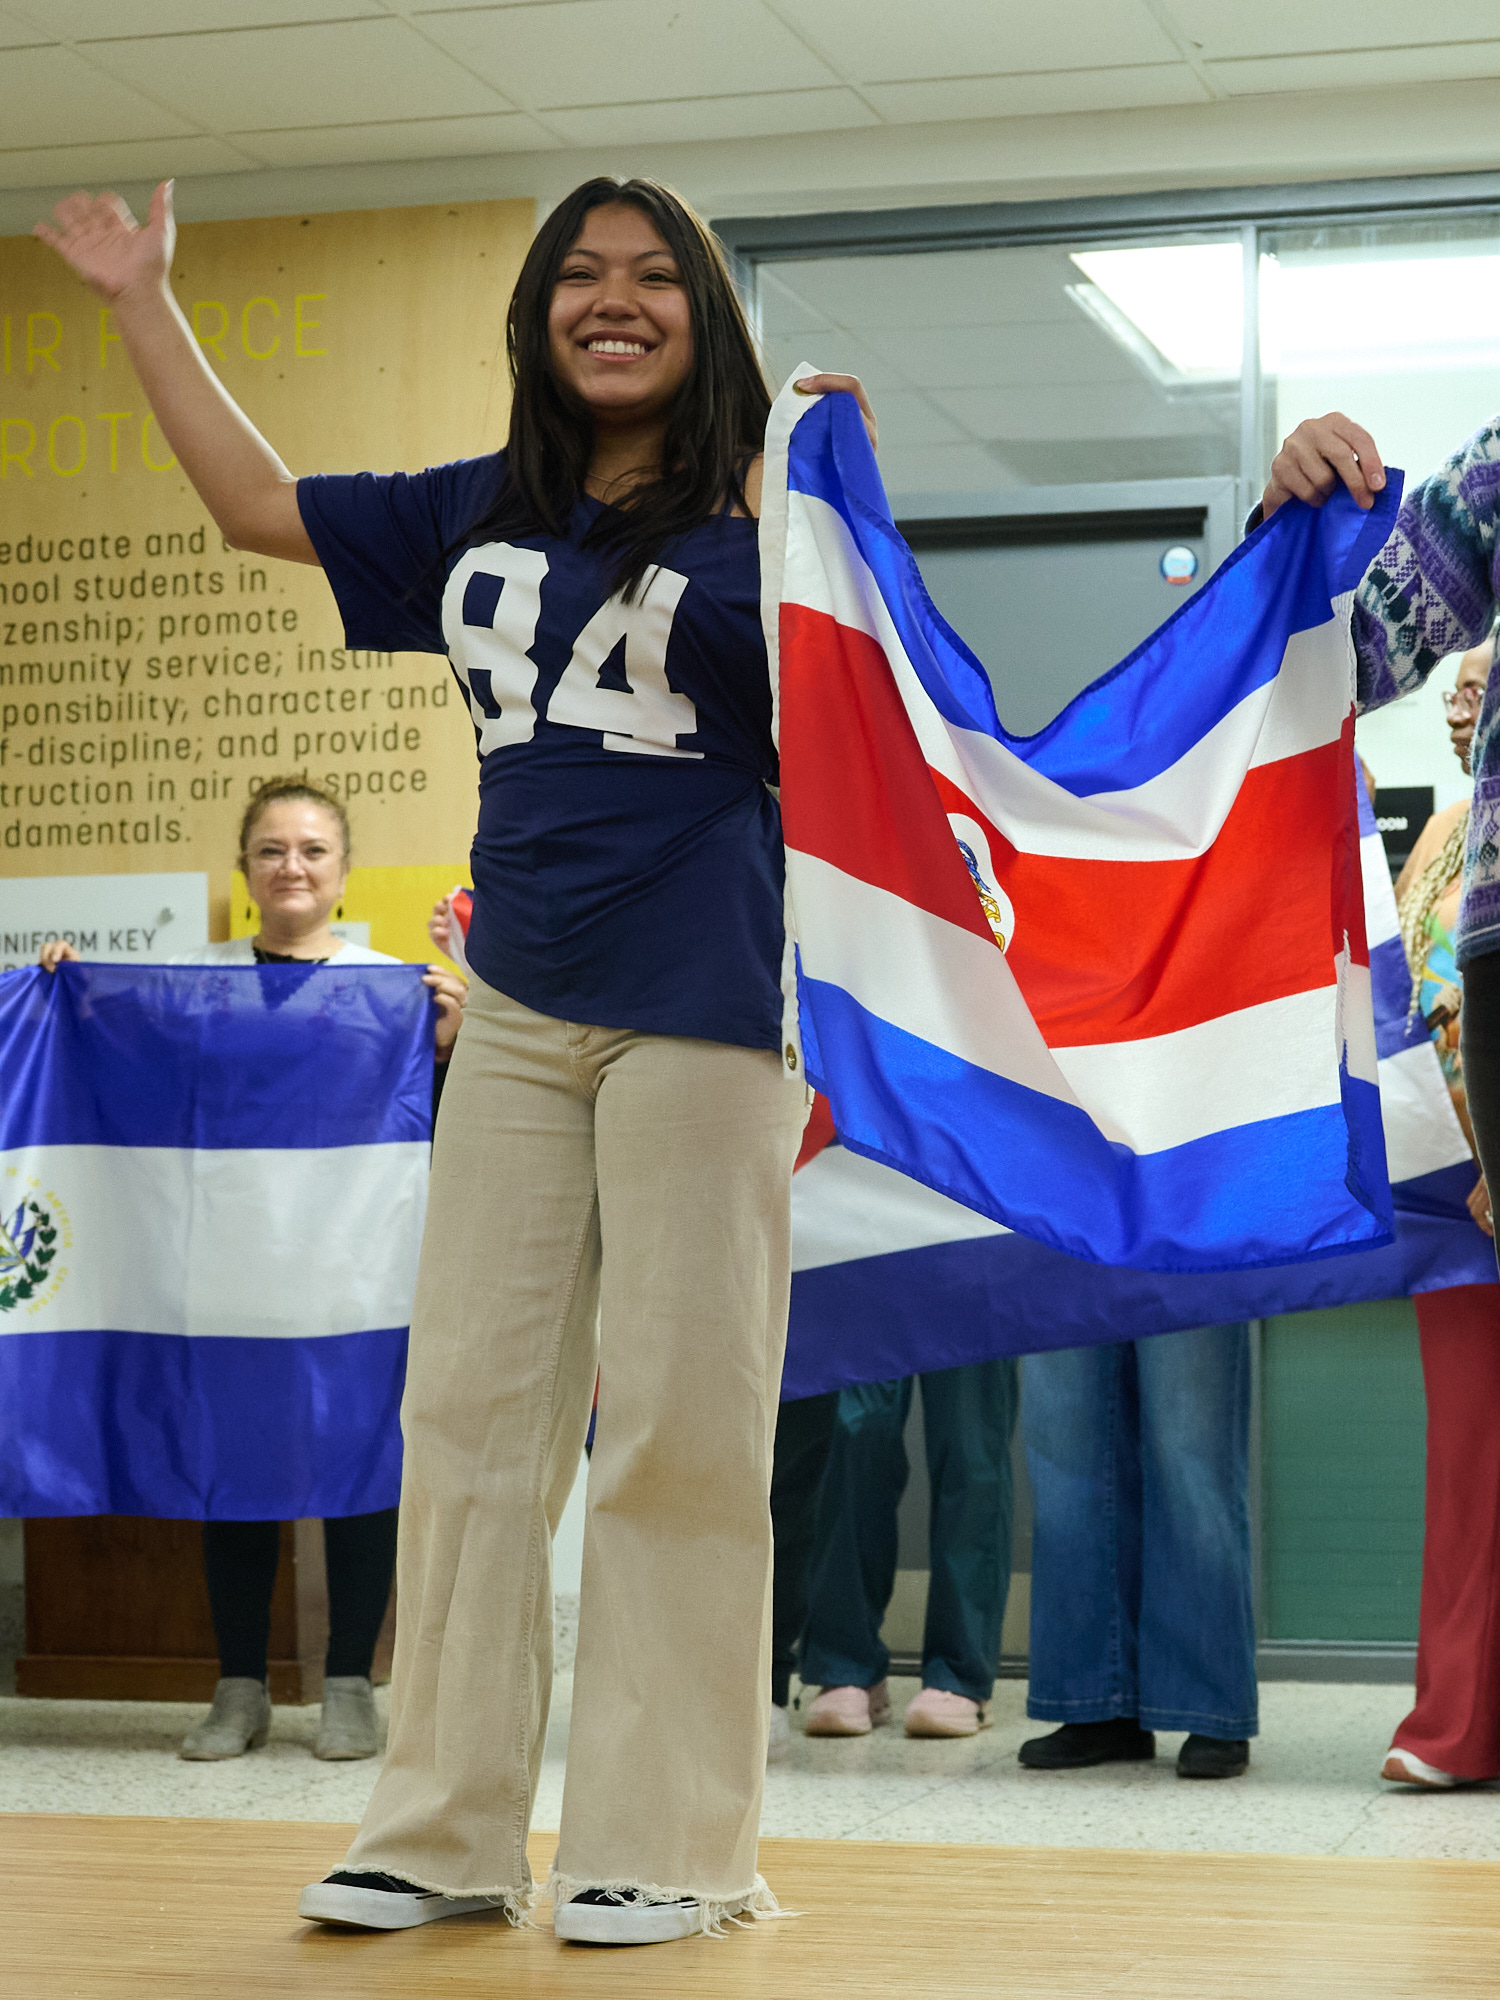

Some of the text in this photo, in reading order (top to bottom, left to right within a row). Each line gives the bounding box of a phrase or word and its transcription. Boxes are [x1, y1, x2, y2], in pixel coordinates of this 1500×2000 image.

[5, 293, 328, 373] IR FRCE
[0, 533, 131, 565] educate
[145, 526, 205, 557] and
[74, 569, 224, 600] students
[239, 563, 267, 592] in
[4, 607, 298, 646] zenship; promote
[146, 646, 282, 680] service;
[442, 541, 705, 759] 84
[3, 679, 449, 732] ponsibility; character and
[0, 722, 421, 768] f-discipline; and provide
[0, 775, 133, 807] truction
[147, 773, 175, 801] in
[190, 770, 233, 801] air
[325, 769, 427, 799] space
[5, 814, 192, 848] damentals.
[0, 928, 156, 954] NIFORM KEY
